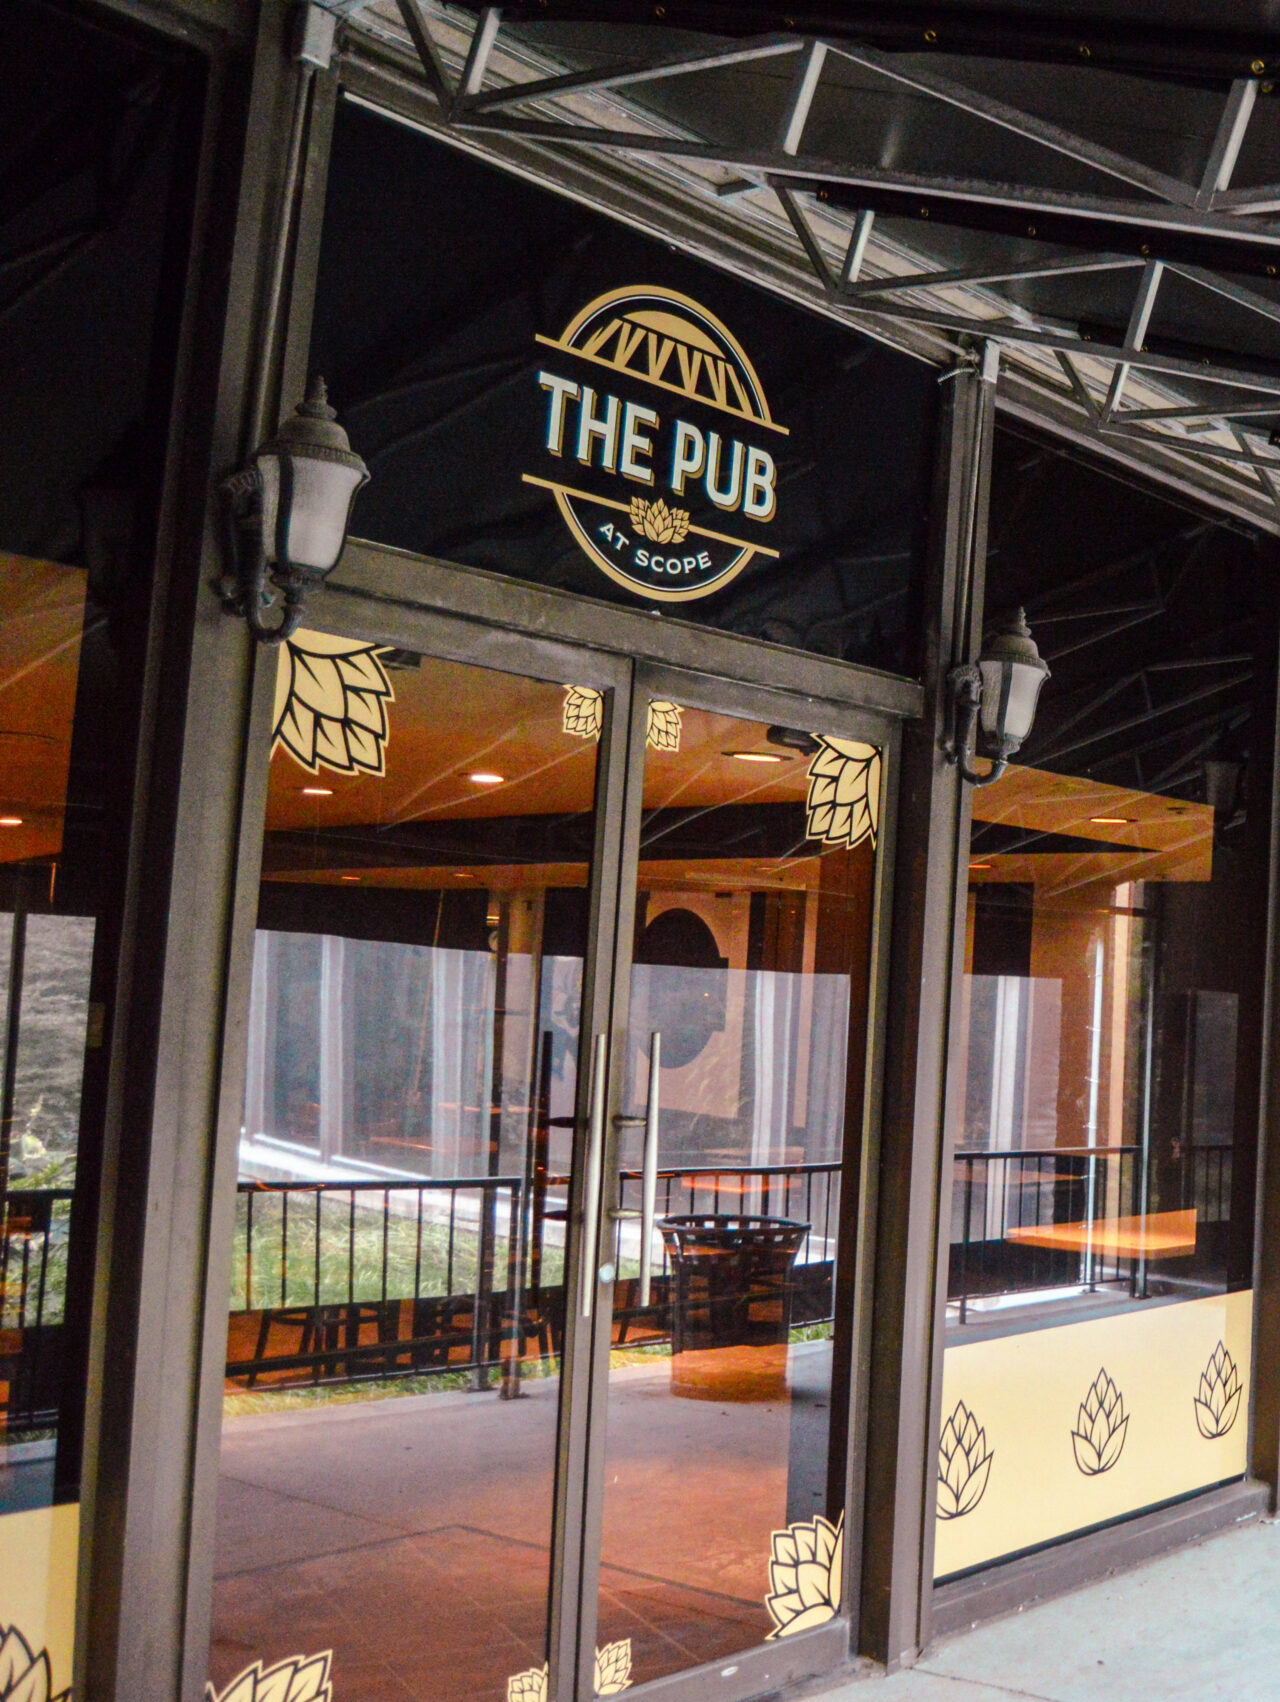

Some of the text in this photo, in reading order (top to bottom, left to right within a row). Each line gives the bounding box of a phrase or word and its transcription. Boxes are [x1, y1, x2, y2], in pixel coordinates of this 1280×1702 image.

[539, 371, 777, 523] THE PUB
[600, 523, 712, 575] AT SCOPE
